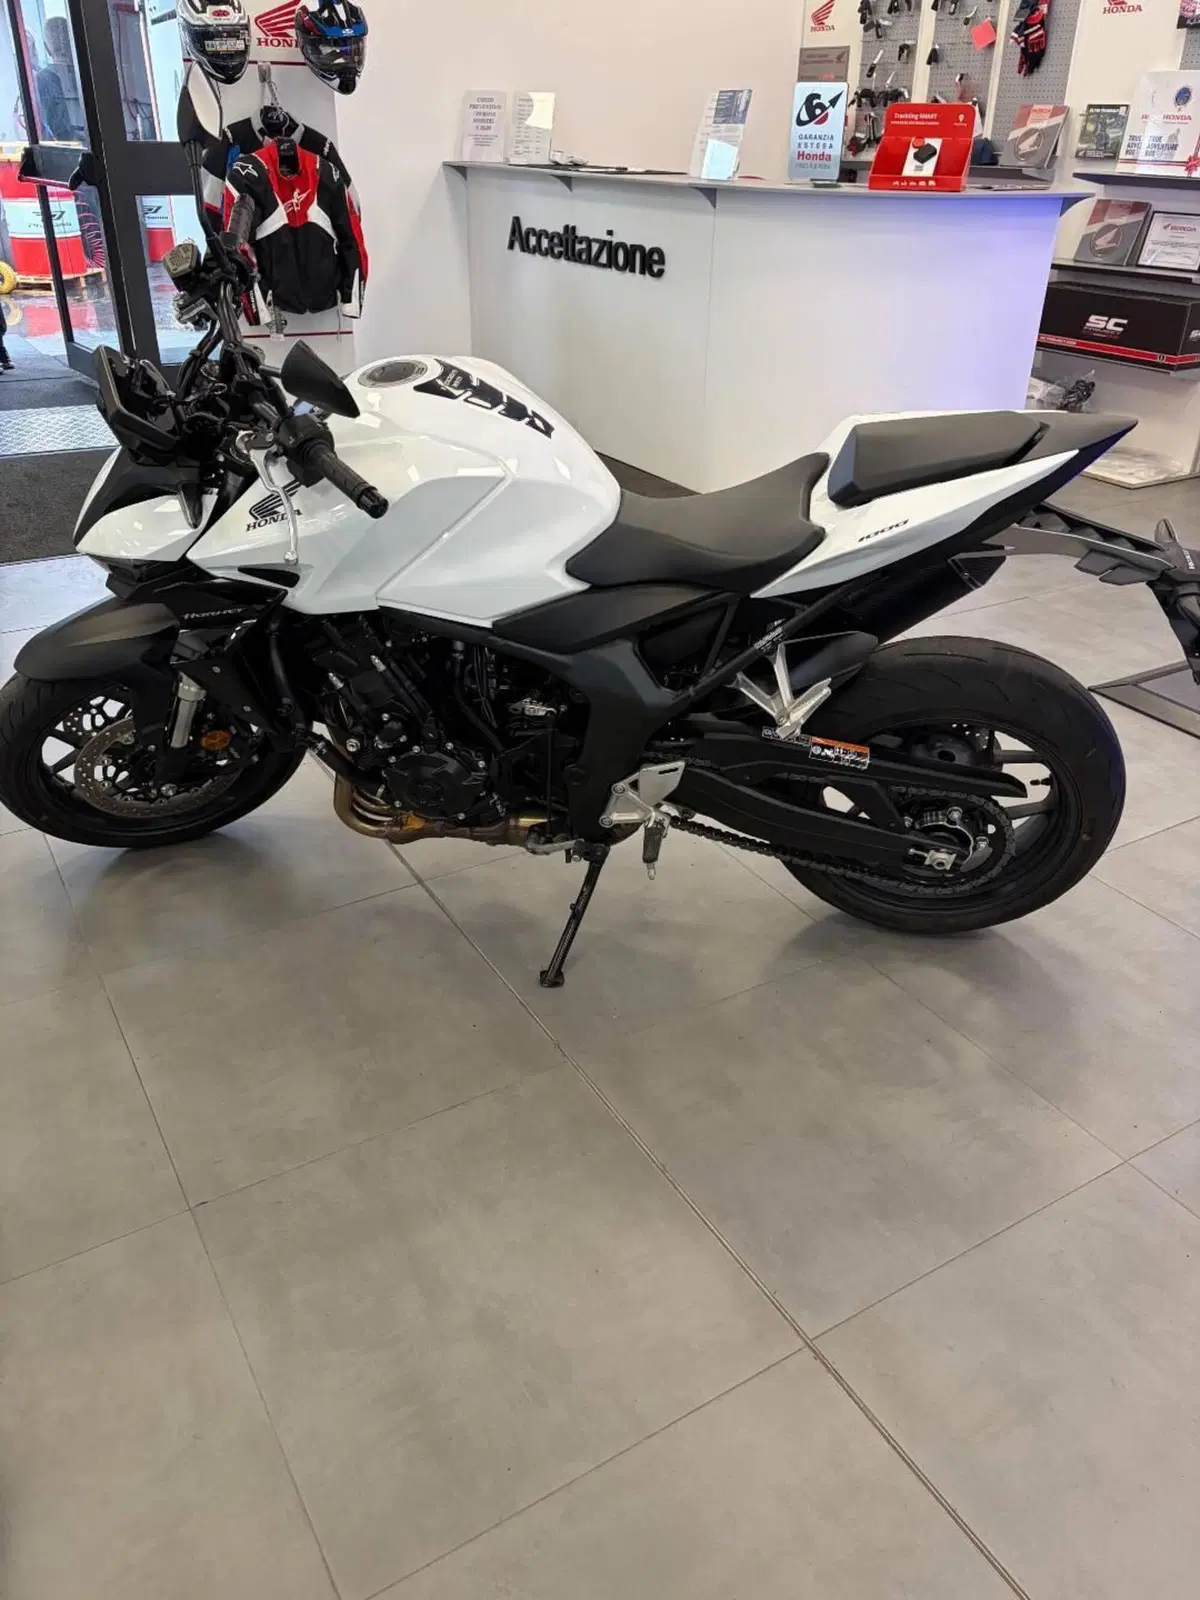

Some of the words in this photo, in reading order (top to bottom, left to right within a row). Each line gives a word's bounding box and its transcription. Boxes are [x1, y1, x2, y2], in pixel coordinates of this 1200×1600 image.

[1102, 4, 1143, 15] HONDA
[810, 24, 836, 33] HONDA
[798, 133, 834, 141] GARANZIA
[797, 141, 833, 149] ESTESA
[797, 150, 832, 162] Honda
[507, 215, 666, 278] Accettazione
[1085, 314, 1129, 332] SC
[858, 518, 909, 543] 1000
